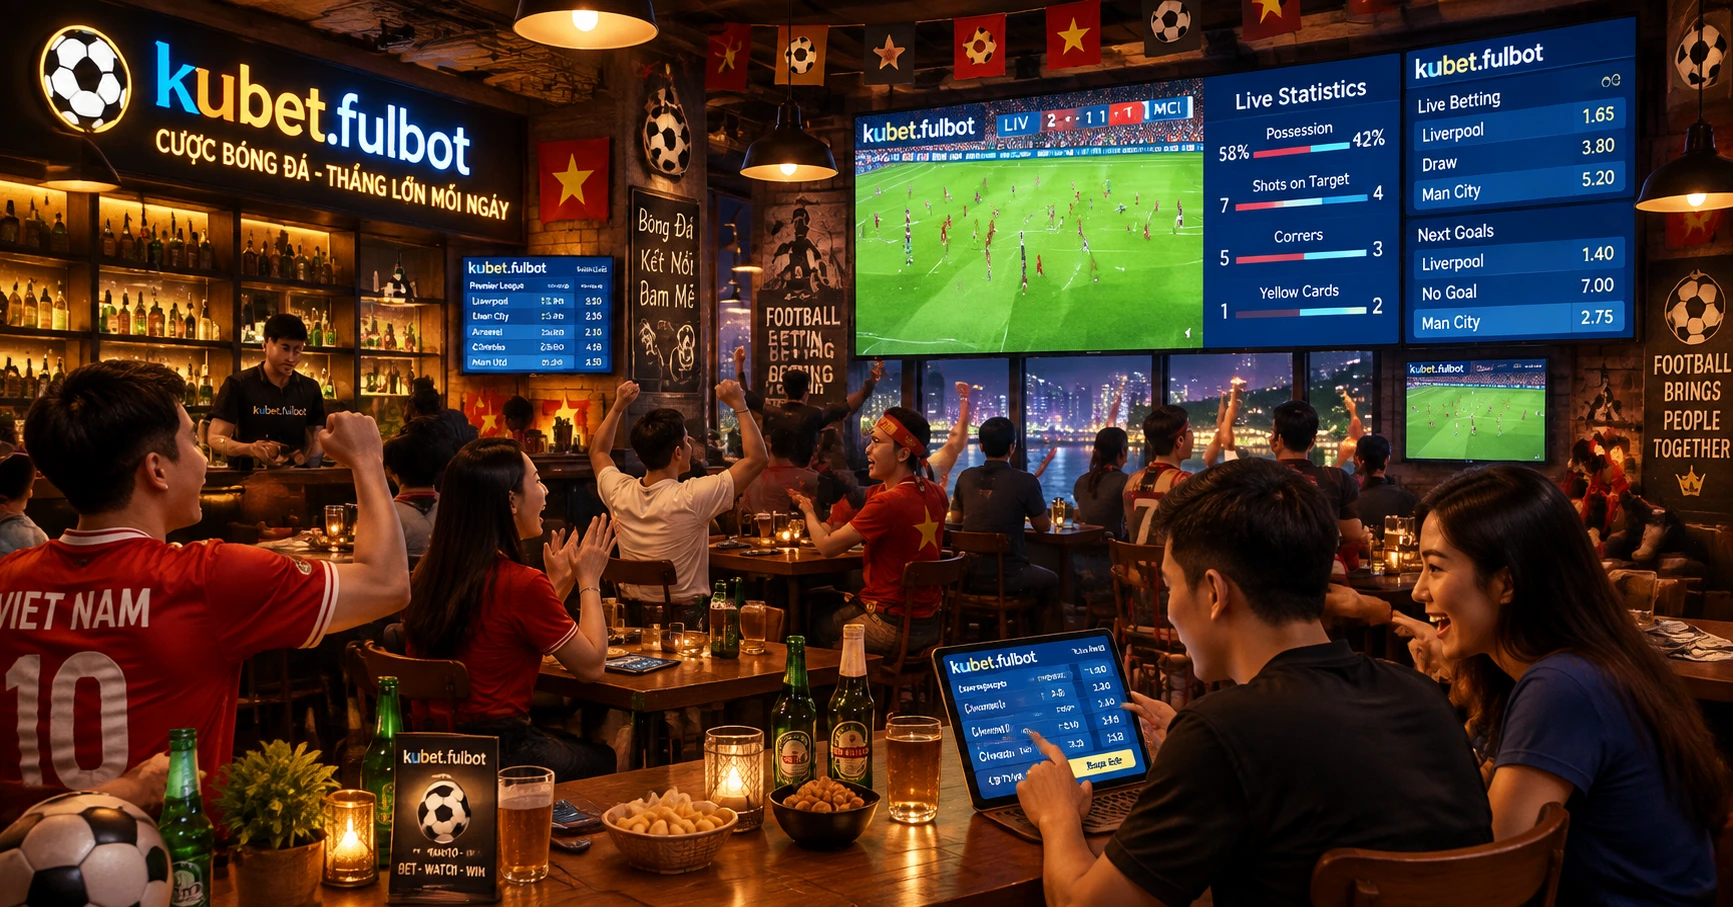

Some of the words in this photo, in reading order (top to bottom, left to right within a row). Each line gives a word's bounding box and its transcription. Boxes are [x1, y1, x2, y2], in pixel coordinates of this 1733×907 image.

[1415, 43, 1544, 79] kubet.fulbot
[1235, 92, 1273, 110] Live
[1279, 79, 1367, 106] Statistics
[1418, 98, 1446, 114] Live
[1450, 92, 1501, 108] Betting
[155, 40, 470, 176] kubet.fulbot
[1154, 102, 1181, 115] MCI
[1582, 106, 1615, 124] 1.65
[863, 117, 975, 143] kubet.fulbot
[1004, 116, 1028, 132] LIV
[1266, 122, 1333, 140] Possession
[1422, 122, 1484, 143] Liverpool
[1352, 128, 1386, 148] 42%
[1582, 137, 1615, 155] 3.80
[156, 128, 216, 165] CƯỢC
[222, 140, 278, 175] BÓNG
[283, 153, 310, 181] ĐÁ
[1219, 144, 1250, 162] 58%
[1422, 157, 1457, 172] Draw
[1253, 179, 1287, 192] Shots
[1290, 178, 1306, 189] on
[1309, 173, 1350, 190] Target
[1582, 170, 1615, 187] 5.20
[1373, 185, 1384, 200] 4
[1422, 187, 1450, 202] Man
[1454, 183, 1481, 201] City
[1220, 198, 1229, 213] 7
[1418, 227, 1451, 243] Next
[1454, 223, 1494, 240] Goals
[1220, 250, 1229, 266] 5
[1373, 241, 1383, 257] 3
[1582, 245, 1614, 262] 1.40
[468, 261, 547, 274] kubet.fulbot
[1422, 253, 1484, 272] Liverpool
[1259, 286, 1299, 300] Yellow
[1302, 284, 1339, 298] Cards
[1422, 287, 1441, 301] No
[1445, 283, 1477, 300] Goal
[1581, 277, 1614, 294] 7.00
[1221, 303, 1227, 319] 1
[1372, 297, 1383, 314] 2
[766, 306, 840, 327] FOOTBALL
[1422, 317, 1450, 331] Man
[1453, 315, 1481, 333] City
[1581, 309, 1614, 325] 2.75
[1654, 353, 1732, 375] FOOTBALL
[1664, 380, 1721, 402] BRINGS
[1663, 410, 1720, 431] PEOPLE
[1653, 438, 1730, 459] TOGETHER
[70, 588, 151, 630] NAM
[949, 650, 1038, 675] kubet.fulbot
[5, 651, 129, 790] 10
[403, 749, 486, 766] kubet.fulbot
